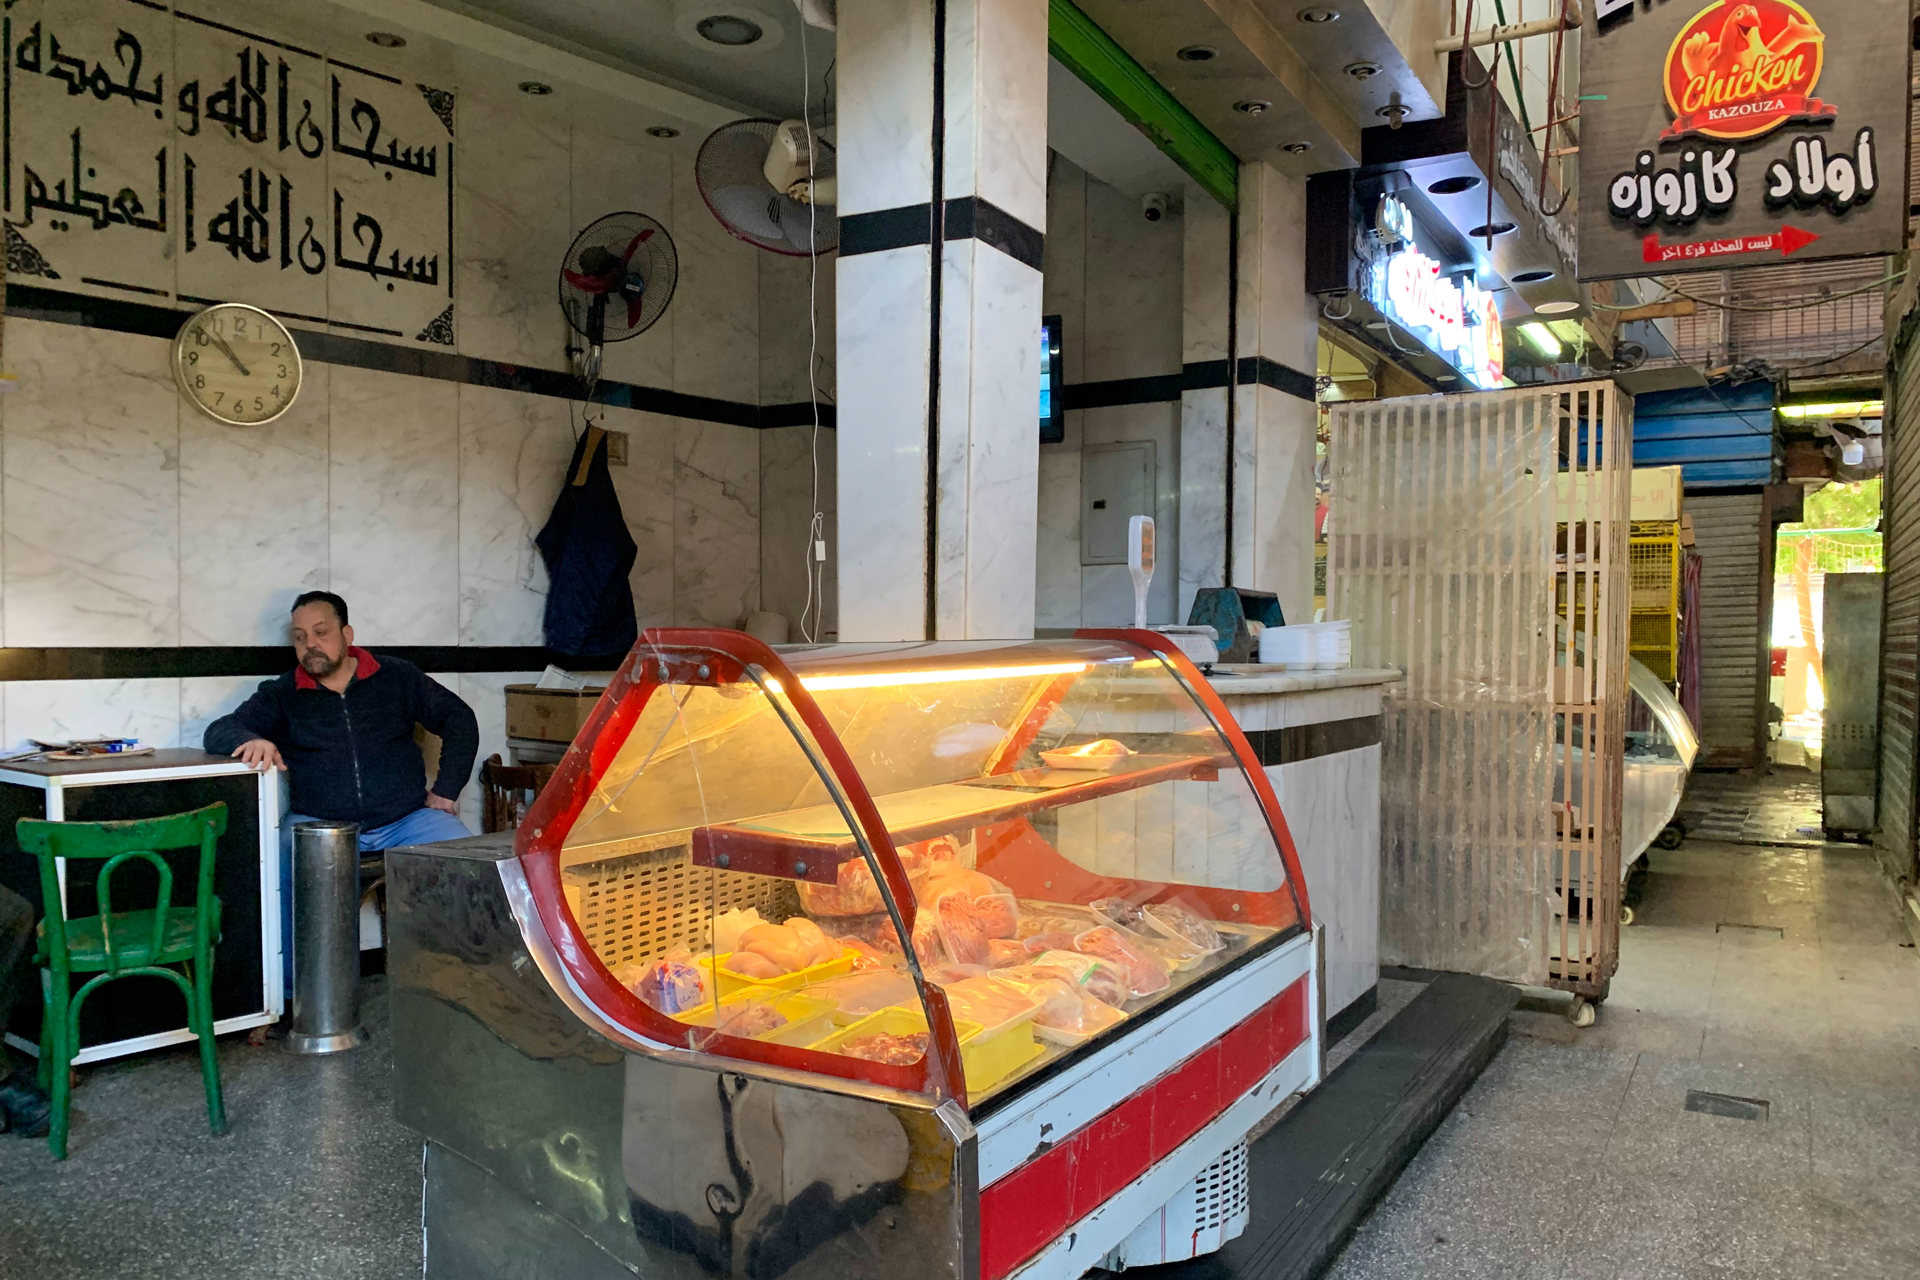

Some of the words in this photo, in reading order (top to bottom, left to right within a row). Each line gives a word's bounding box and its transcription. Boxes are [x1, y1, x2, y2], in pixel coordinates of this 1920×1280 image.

[1682, 54, 1806, 113] Chicken
[206, 46, 291, 152] الله
[1708, 99, 1785, 120] KAZOUZA
[295, 73, 436, 181] سبحان
[1769, 131, 1874, 202] أولاد
[11, 126, 196, 254] العظيم
[207, 167, 293, 271] الله
[298, 188, 438, 292] سبحان
[1710, 239, 1744, 255] للمحل
[1747, 236, 1773, 250] ليس
[1685, 242, 1706, 258] فرع
[233, 315, 247, 332] 12
[271, 342, 281, 357] 2
[188, 351, 199, 366] 9
[277, 364, 287, 379] 3
[195, 374, 206, 389] 8
[214, 391, 225, 406] 7
[270, 384, 280, 398] 4
[233, 399, 243, 414] 6
[254, 396, 264, 411] 5
